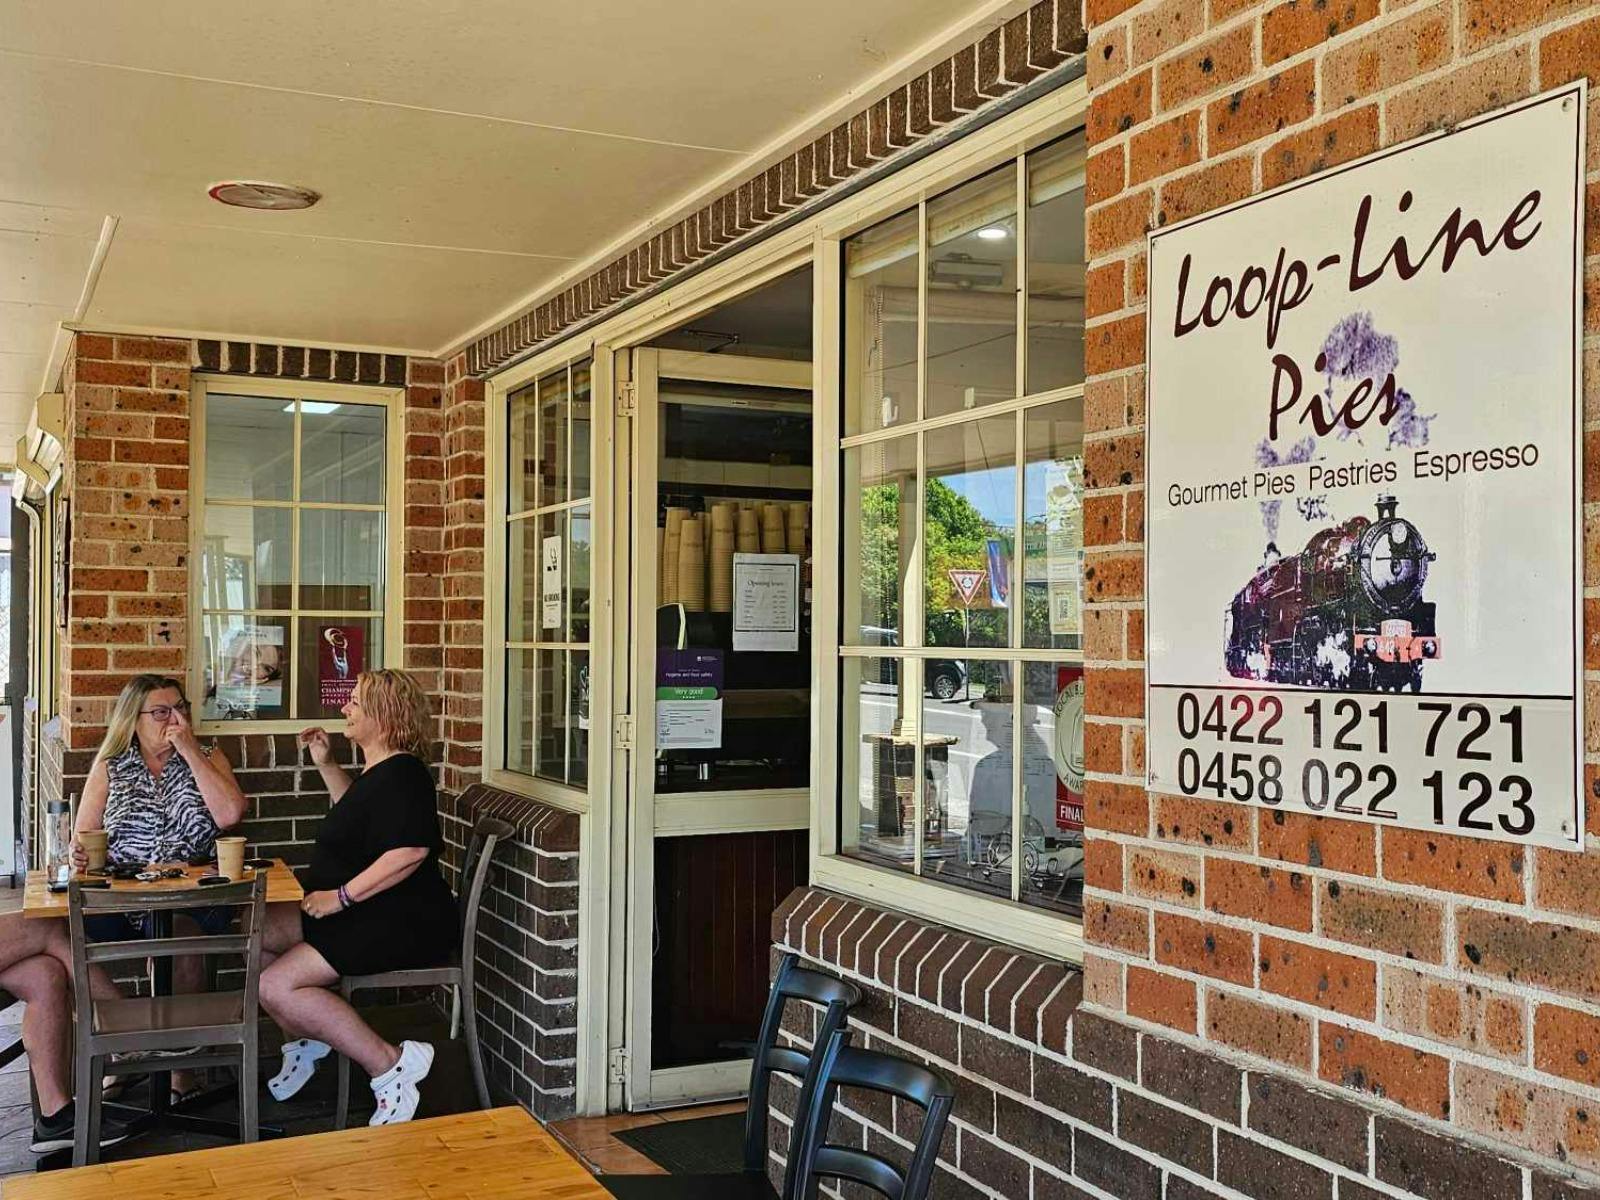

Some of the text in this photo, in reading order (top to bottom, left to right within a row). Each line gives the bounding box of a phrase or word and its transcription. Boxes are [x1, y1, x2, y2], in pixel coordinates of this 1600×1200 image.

[1174, 189, 1543, 349] Loop-Line
[1268, 351, 1398, 441] Pies
[1168, 442, 1539, 506] Gourmet Pies Pastries Espresso
[674, 687, 704, 696] Very good
[1177, 692, 1523, 763] 0422 121 721
[1060, 805, 1084, 822] FINAL
[1177, 747, 1536, 836] 0458 022 123
